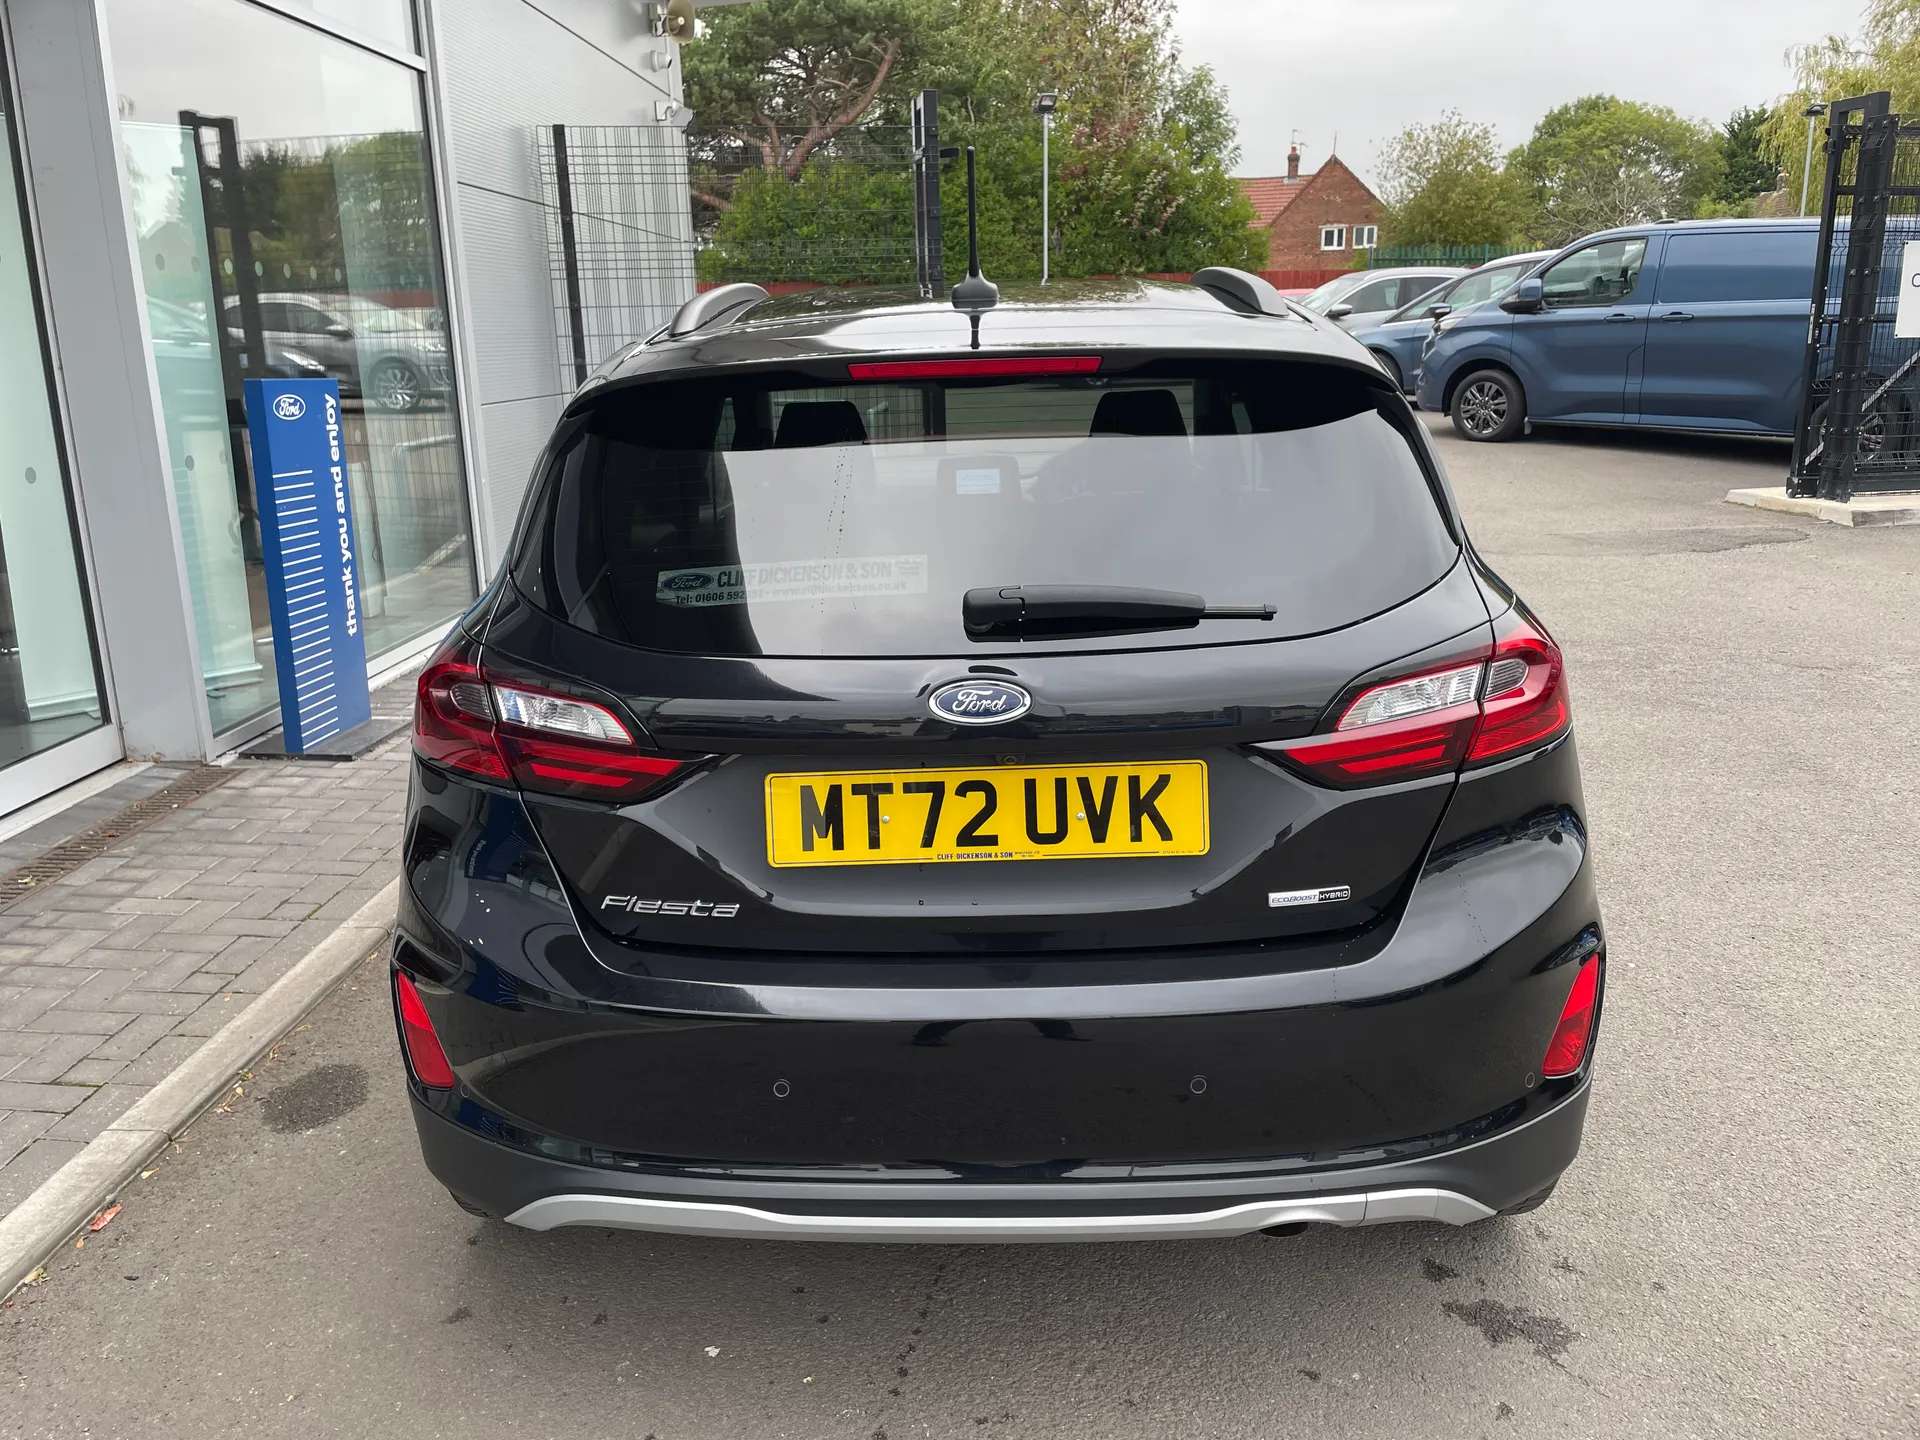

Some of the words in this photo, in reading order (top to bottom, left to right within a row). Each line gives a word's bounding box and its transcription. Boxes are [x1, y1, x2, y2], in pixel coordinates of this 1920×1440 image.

[324, 393, 340, 462] enjoy
[330, 466, 346, 512] and
[338, 518, 353, 563] you
[717, 568, 757, 588] CLIFF
[759, 561, 843, 585] DICKENSON
[845, 562, 857, 578] &
[859, 560, 893, 578] SON
[342, 566, 358, 637] thank
[675, 595, 693, 604] Tel:
[695, 592, 725, 602] 01606
[800, 780, 999, 852] MT72
[1024, 773, 1173, 845] UVK
[956, 852, 993, 860] DICKENSON
[600, 895, 740, 918] Fiesta
[1319, 890, 1349, 900] HYBRID
